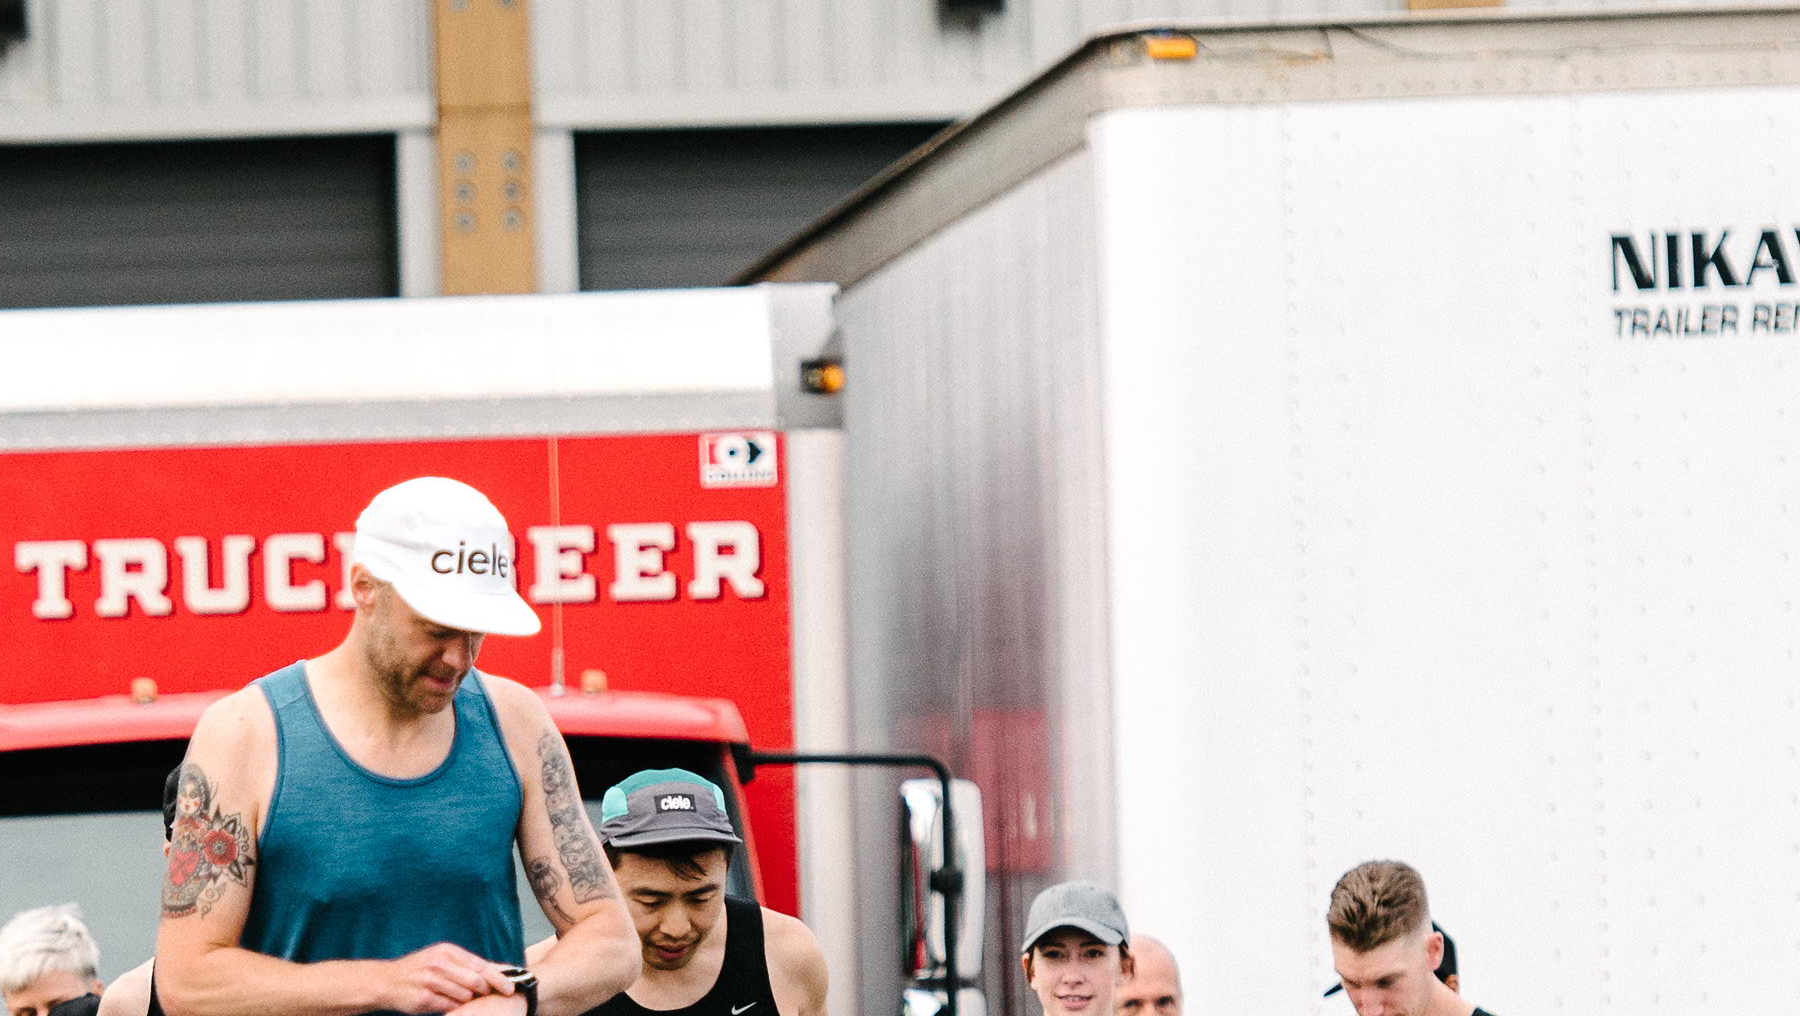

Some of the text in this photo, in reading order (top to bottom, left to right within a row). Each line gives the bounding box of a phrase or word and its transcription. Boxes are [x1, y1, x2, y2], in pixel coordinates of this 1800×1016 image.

[1611, 229, 1800, 291] NIKA
[1614, 304, 1739, 338] TRAILER
[431, 540, 508, 578] ciele
[506, 520, 765, 603] EER
